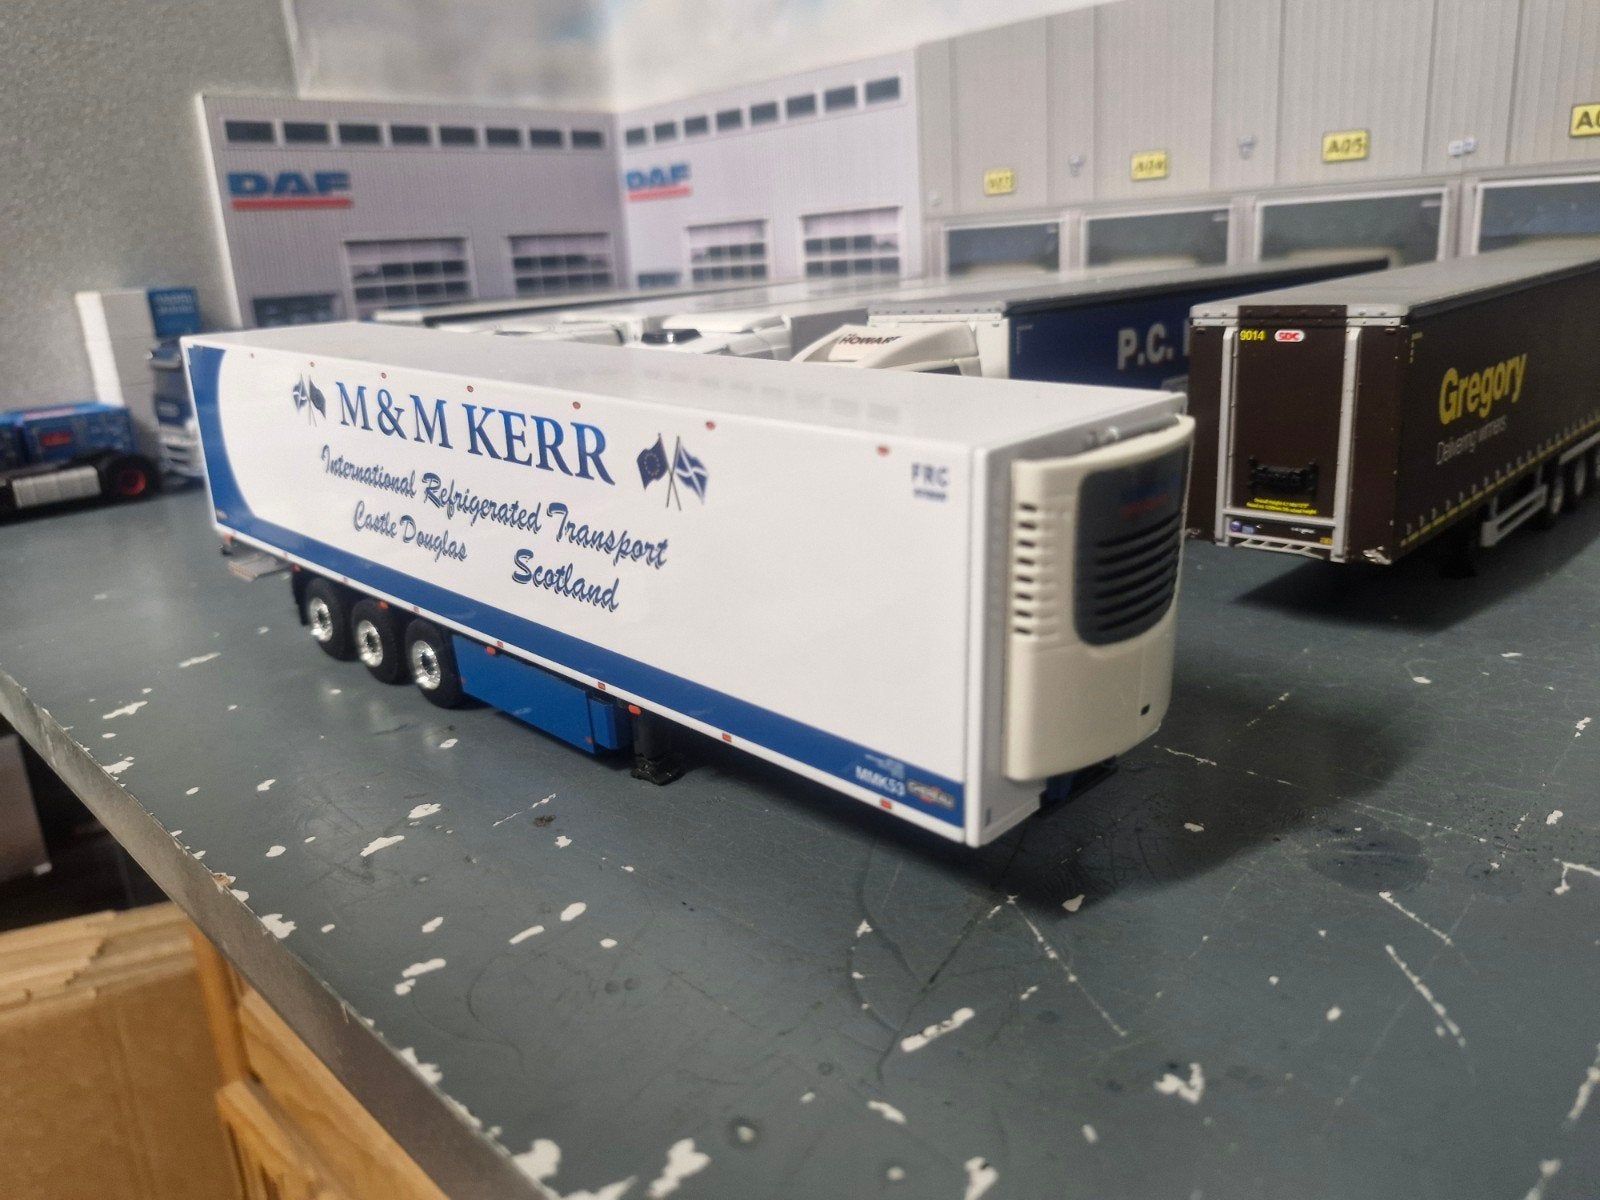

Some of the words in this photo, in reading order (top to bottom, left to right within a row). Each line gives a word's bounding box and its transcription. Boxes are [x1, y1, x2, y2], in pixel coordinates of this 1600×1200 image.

[228, 172, 351, 196] DAF
[626, 163, 690, 189] DAF
[1117, 323, 1174, 370] P.C.
[1240, 329, 1266, 341] 9014
[1278, 331, 1301, 341] SDC
[1439, 353, 1528, 425] Gregory
[335, 380, 454, 450] M&M
[461, 403, 616, 486] KERR
[911, 463, 949, 488] FRC
[321, 444, 417, 499] International
[421, 472, 542, 534] Refrigerated
[546, 502, 669, 570] Transport
[353, 500, 398, 538] Castle
[400, 514, 468, 563] Douglas
[512, 548, 620, 613] Scotland
